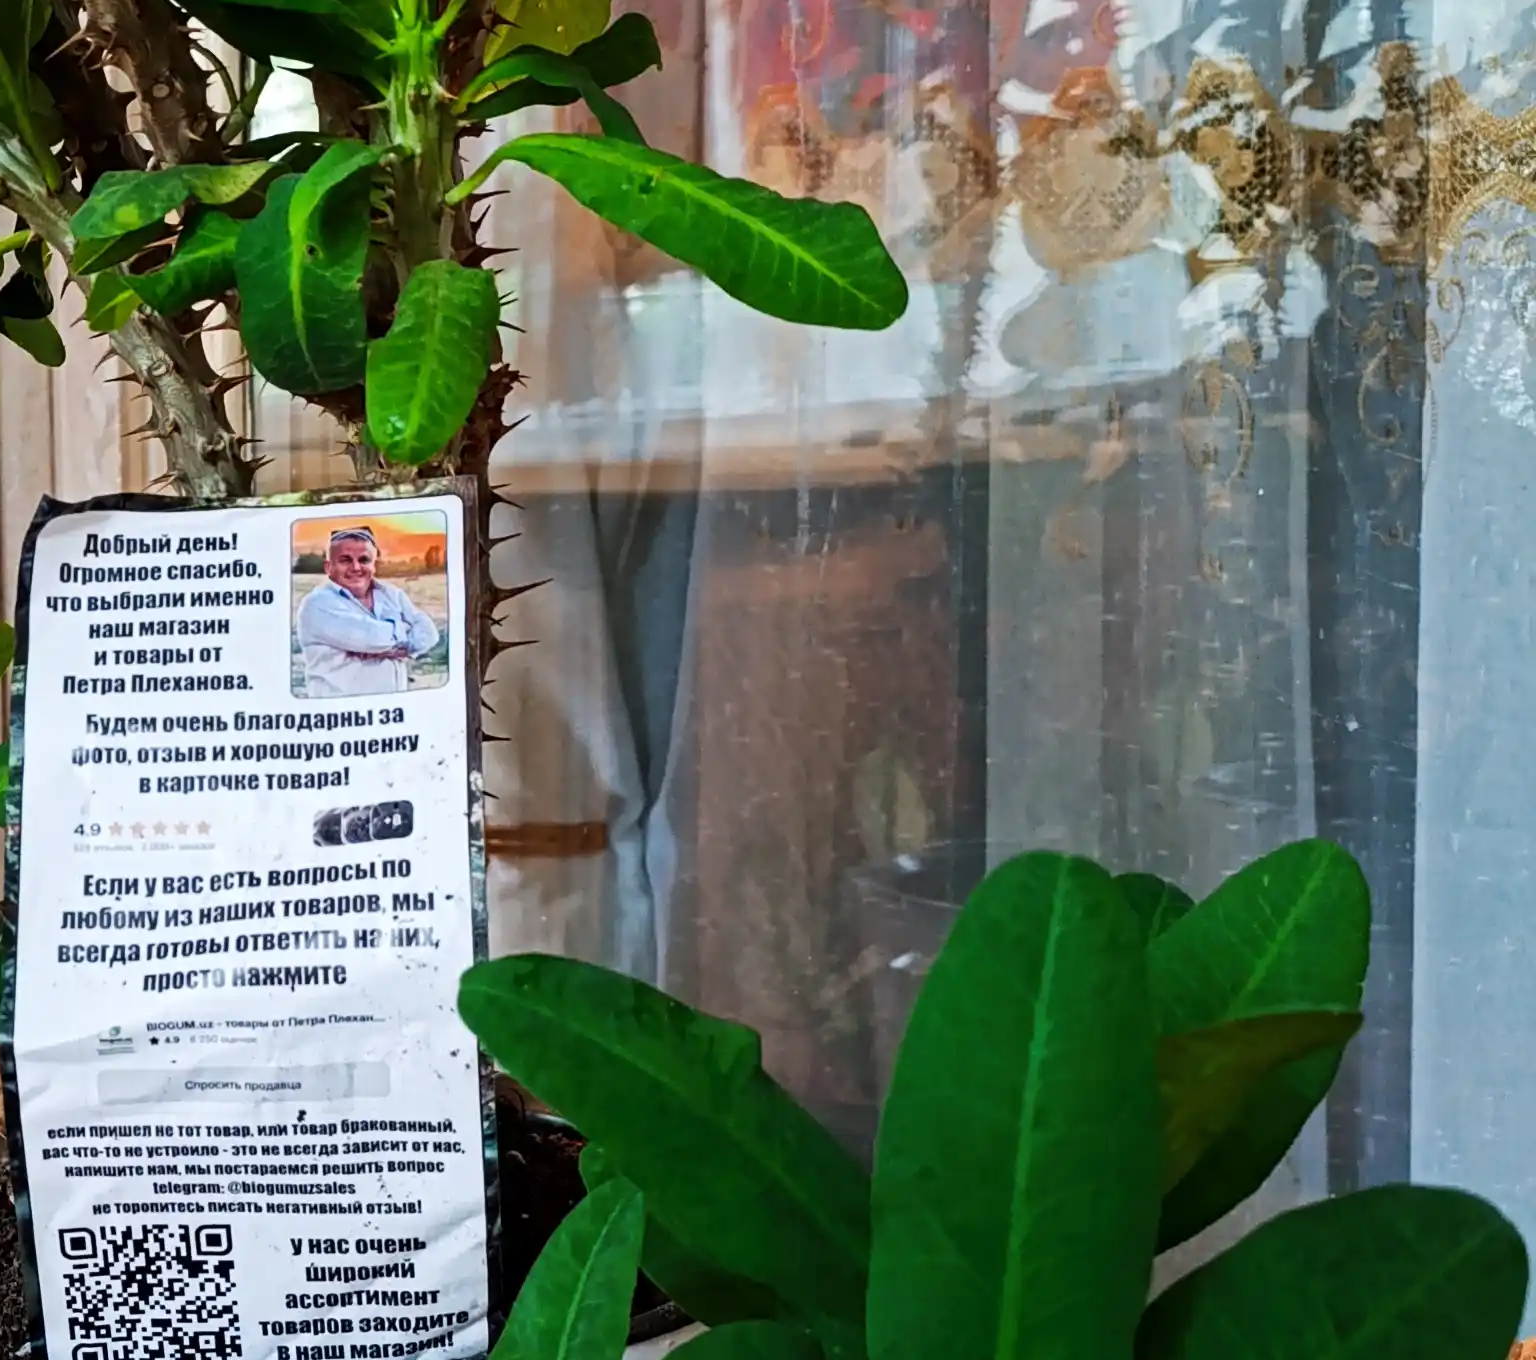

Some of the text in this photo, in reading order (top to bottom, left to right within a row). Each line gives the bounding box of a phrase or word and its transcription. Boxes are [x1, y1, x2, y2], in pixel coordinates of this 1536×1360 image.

[83, 532, 238, 557] Добрый день!
[59, 559, 262, 585] Огромное спасибо,
[46, 589, 274, 612] что выбрали именно
[89, 618, 230, 639] наш магазин
[94, 646, 223, 666] и товары от
[63, 673, 253, 695] Петра Плеханова.
[86, 707, 404, 736] Будем очень благодарны за
[72, 734, 419, 766] фото, отзыв и хорошую оценку
[139, 766, 350, 794] в карточке товара!
[73, 823, 101, 836] 4.9
[83, 858, 411, 897] Если у вас есть вопросы по
[61, 892, 435, 930] любому из наших товаров, мы
[58, 926, 440, 968] всегда готовы ответить на них,
[143, 965, 347, 992] просто нажмите
[225, 1019, 269, 1029] товары
[288, 1016, 325, 1027] Петра
[184, 1079, 302, 1092] Спросить продавца
[47, 1125, 86, 1139] если
[89, 1125, 151, 1139] пришел
[155, 1124, 173, 1137] не
[177, 1124, 202, 1137] тот
[257, 1124, 288, 1136] или
[292, 1122, 337, 1136] товар
[42, 1146, 69, 1160] вас
[72, 1145, 121, 1158] что-то
[125, 1145, 143, 1157] не
[146, 1144, 219, 1158] устроило
[231, 1144, 257, 1156] это
[261, 1144, 280, 1156] не
[283, 1144, 338, 1157] всегда
[342, 1140, 408, 1155] зависит
[411, 1141, 429, 1153] от
[433, 1140, 465, 1154] нас,
[65, 1165, 144, 1177] напишите
[184, 1164, 211, 1175] мы
[214, 1163, 318, 1176] постараемся
[322, 1161, 384, 1175] решить
[387, 1160, 445, 1173] вопрос
[153, 1181, 356, 1196] telegram: @biogumuzsales
[93, 1199, 423, 1215] не торопитесь писать негативный отзыв!
[289, 1237, 427, 1256] у нас очень
[305, 1258, 415, 1283] широкий
[285, 1289, 440, 1309] ассортимент
[259, 1310, 469, 1336] товаров заходите
[277, 1331, 454, 1360] в наш магазин!
